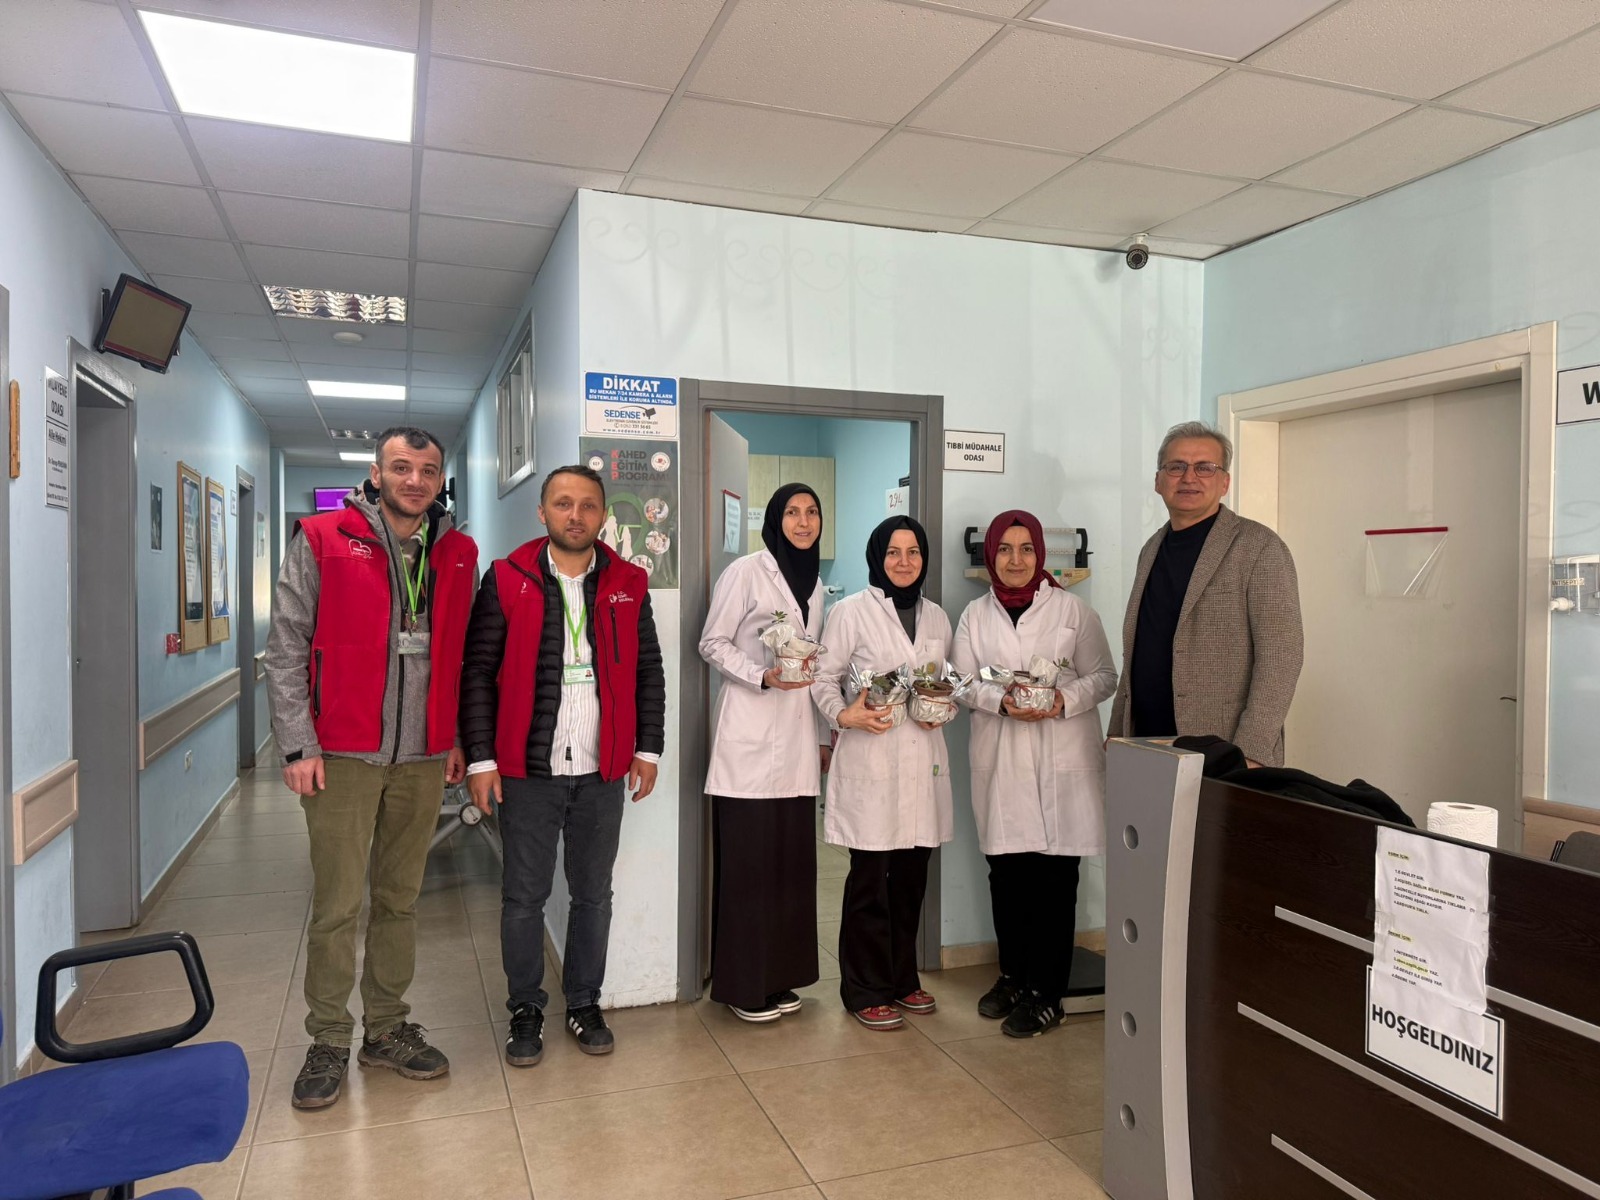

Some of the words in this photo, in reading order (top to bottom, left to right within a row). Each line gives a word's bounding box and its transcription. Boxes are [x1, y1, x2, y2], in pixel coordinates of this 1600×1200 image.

[603, 375, 660, 392] DİKKAT
[604, 409, 641, 419] SEDENSE
[965, 442, 1002, 452] MÜDAHALE
[611, 450, 647, 460] KAHED
[611, 460, 648, 471] EĞİTİM
